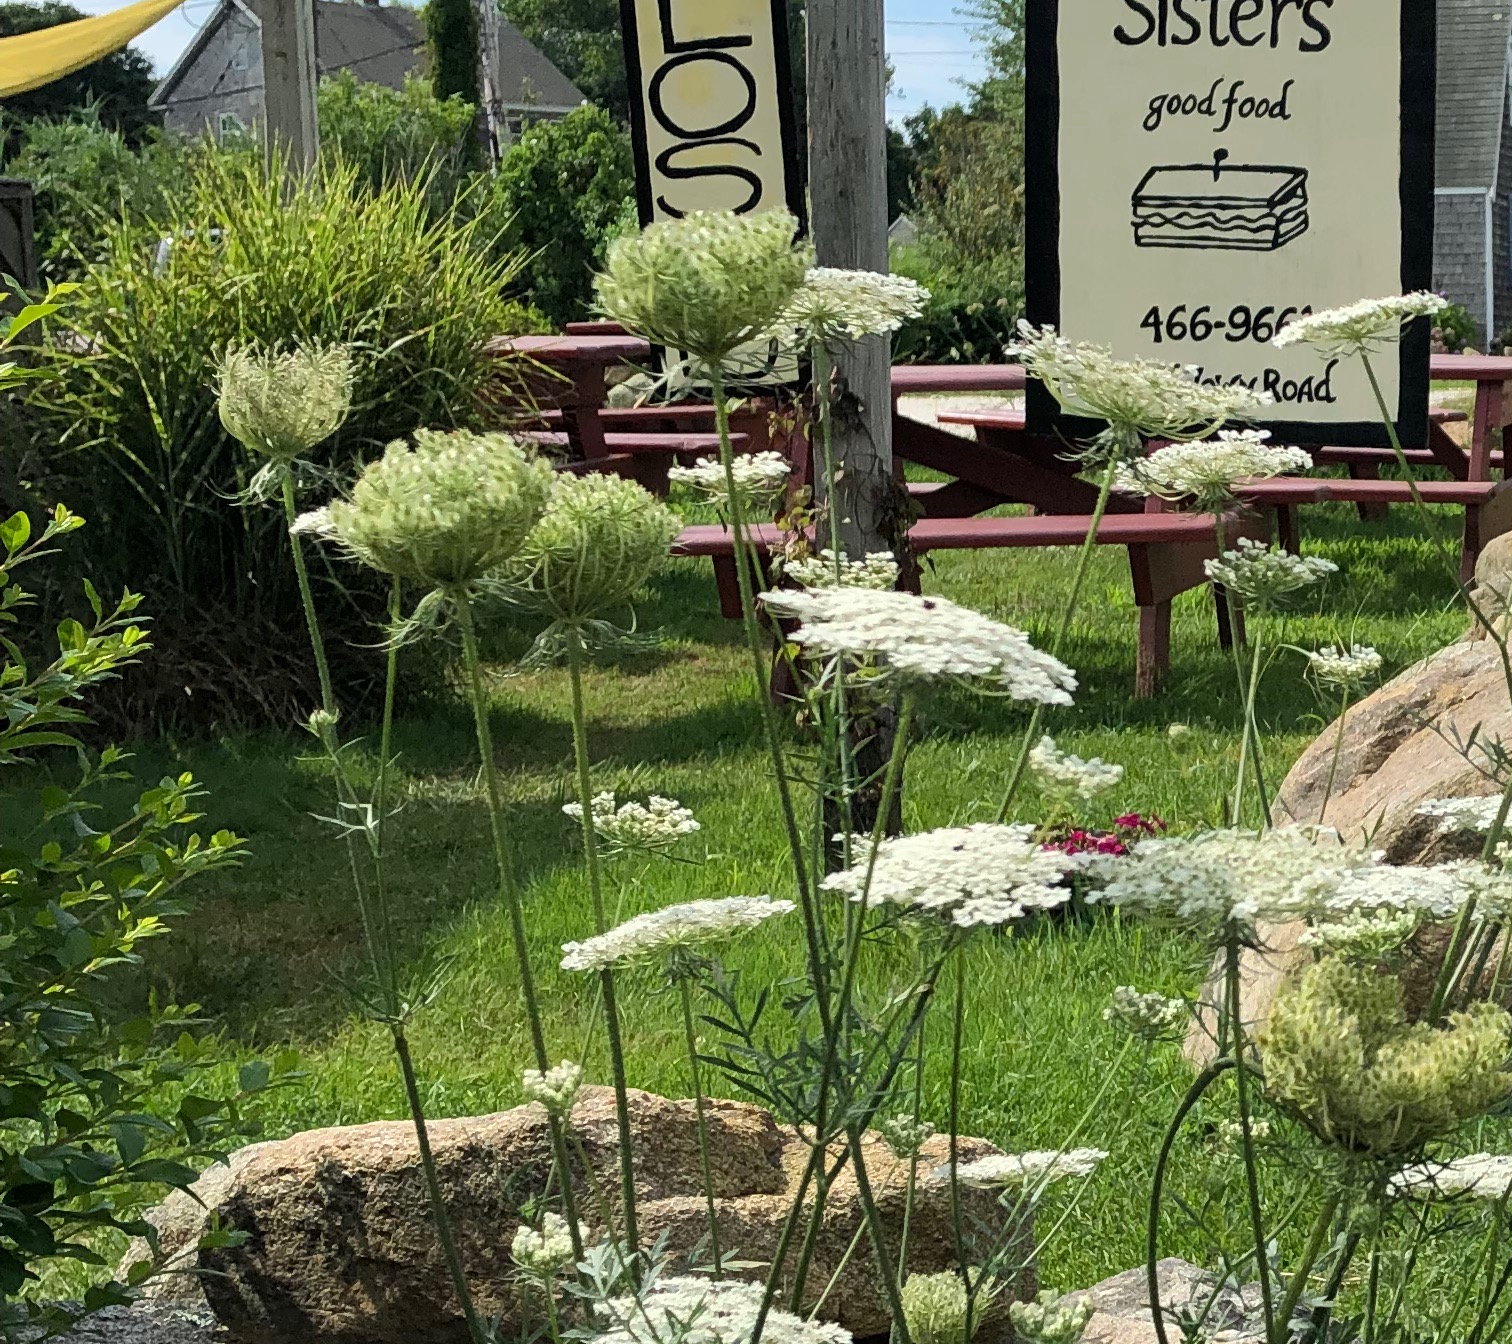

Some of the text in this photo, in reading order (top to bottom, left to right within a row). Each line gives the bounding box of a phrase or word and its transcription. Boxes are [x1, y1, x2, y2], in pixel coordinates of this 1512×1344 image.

[1142, 77, 1295, 133] good food
[1139, 304, 1313, 344] 466-966
